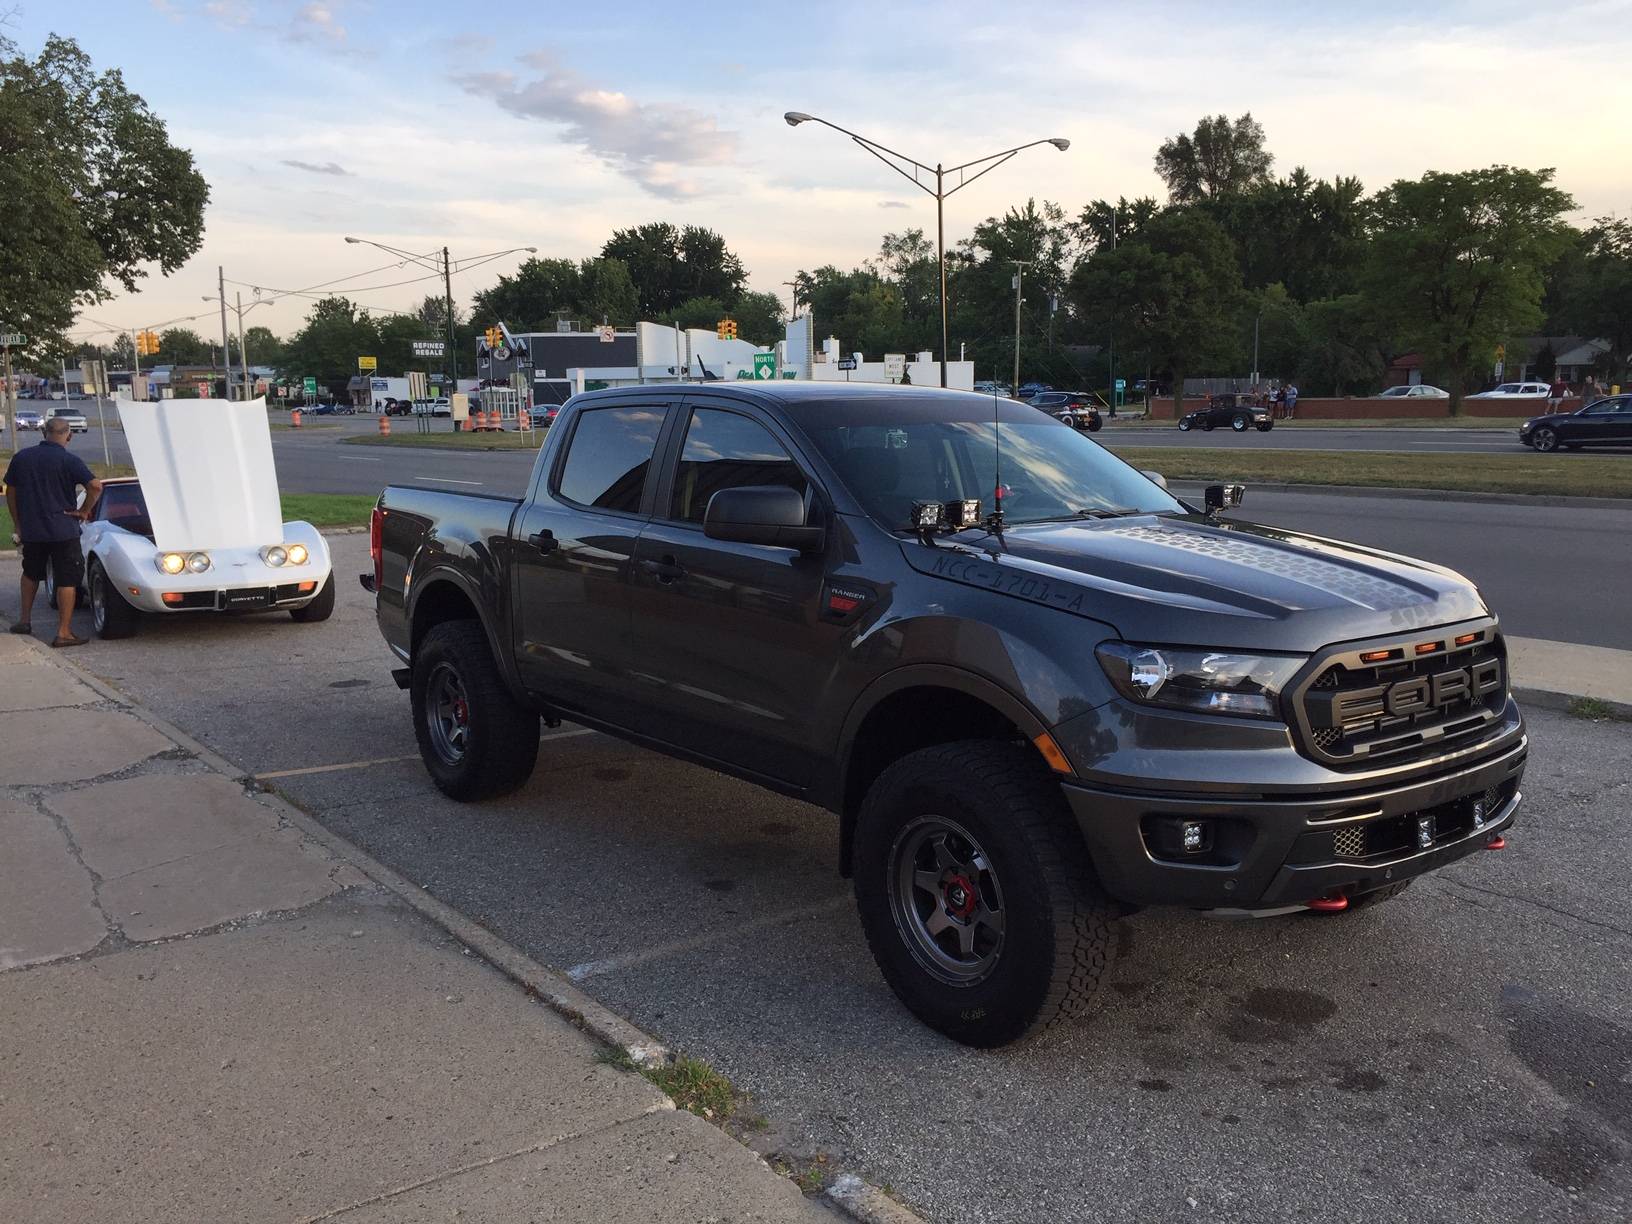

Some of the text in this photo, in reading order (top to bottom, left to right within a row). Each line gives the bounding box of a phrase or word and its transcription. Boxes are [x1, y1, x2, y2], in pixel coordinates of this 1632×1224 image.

[831, 588, 865, 600] RANGER
[932, 556, 1084, 611] NCC-1701-A
[1332, 657, 1501, 728] FORD
